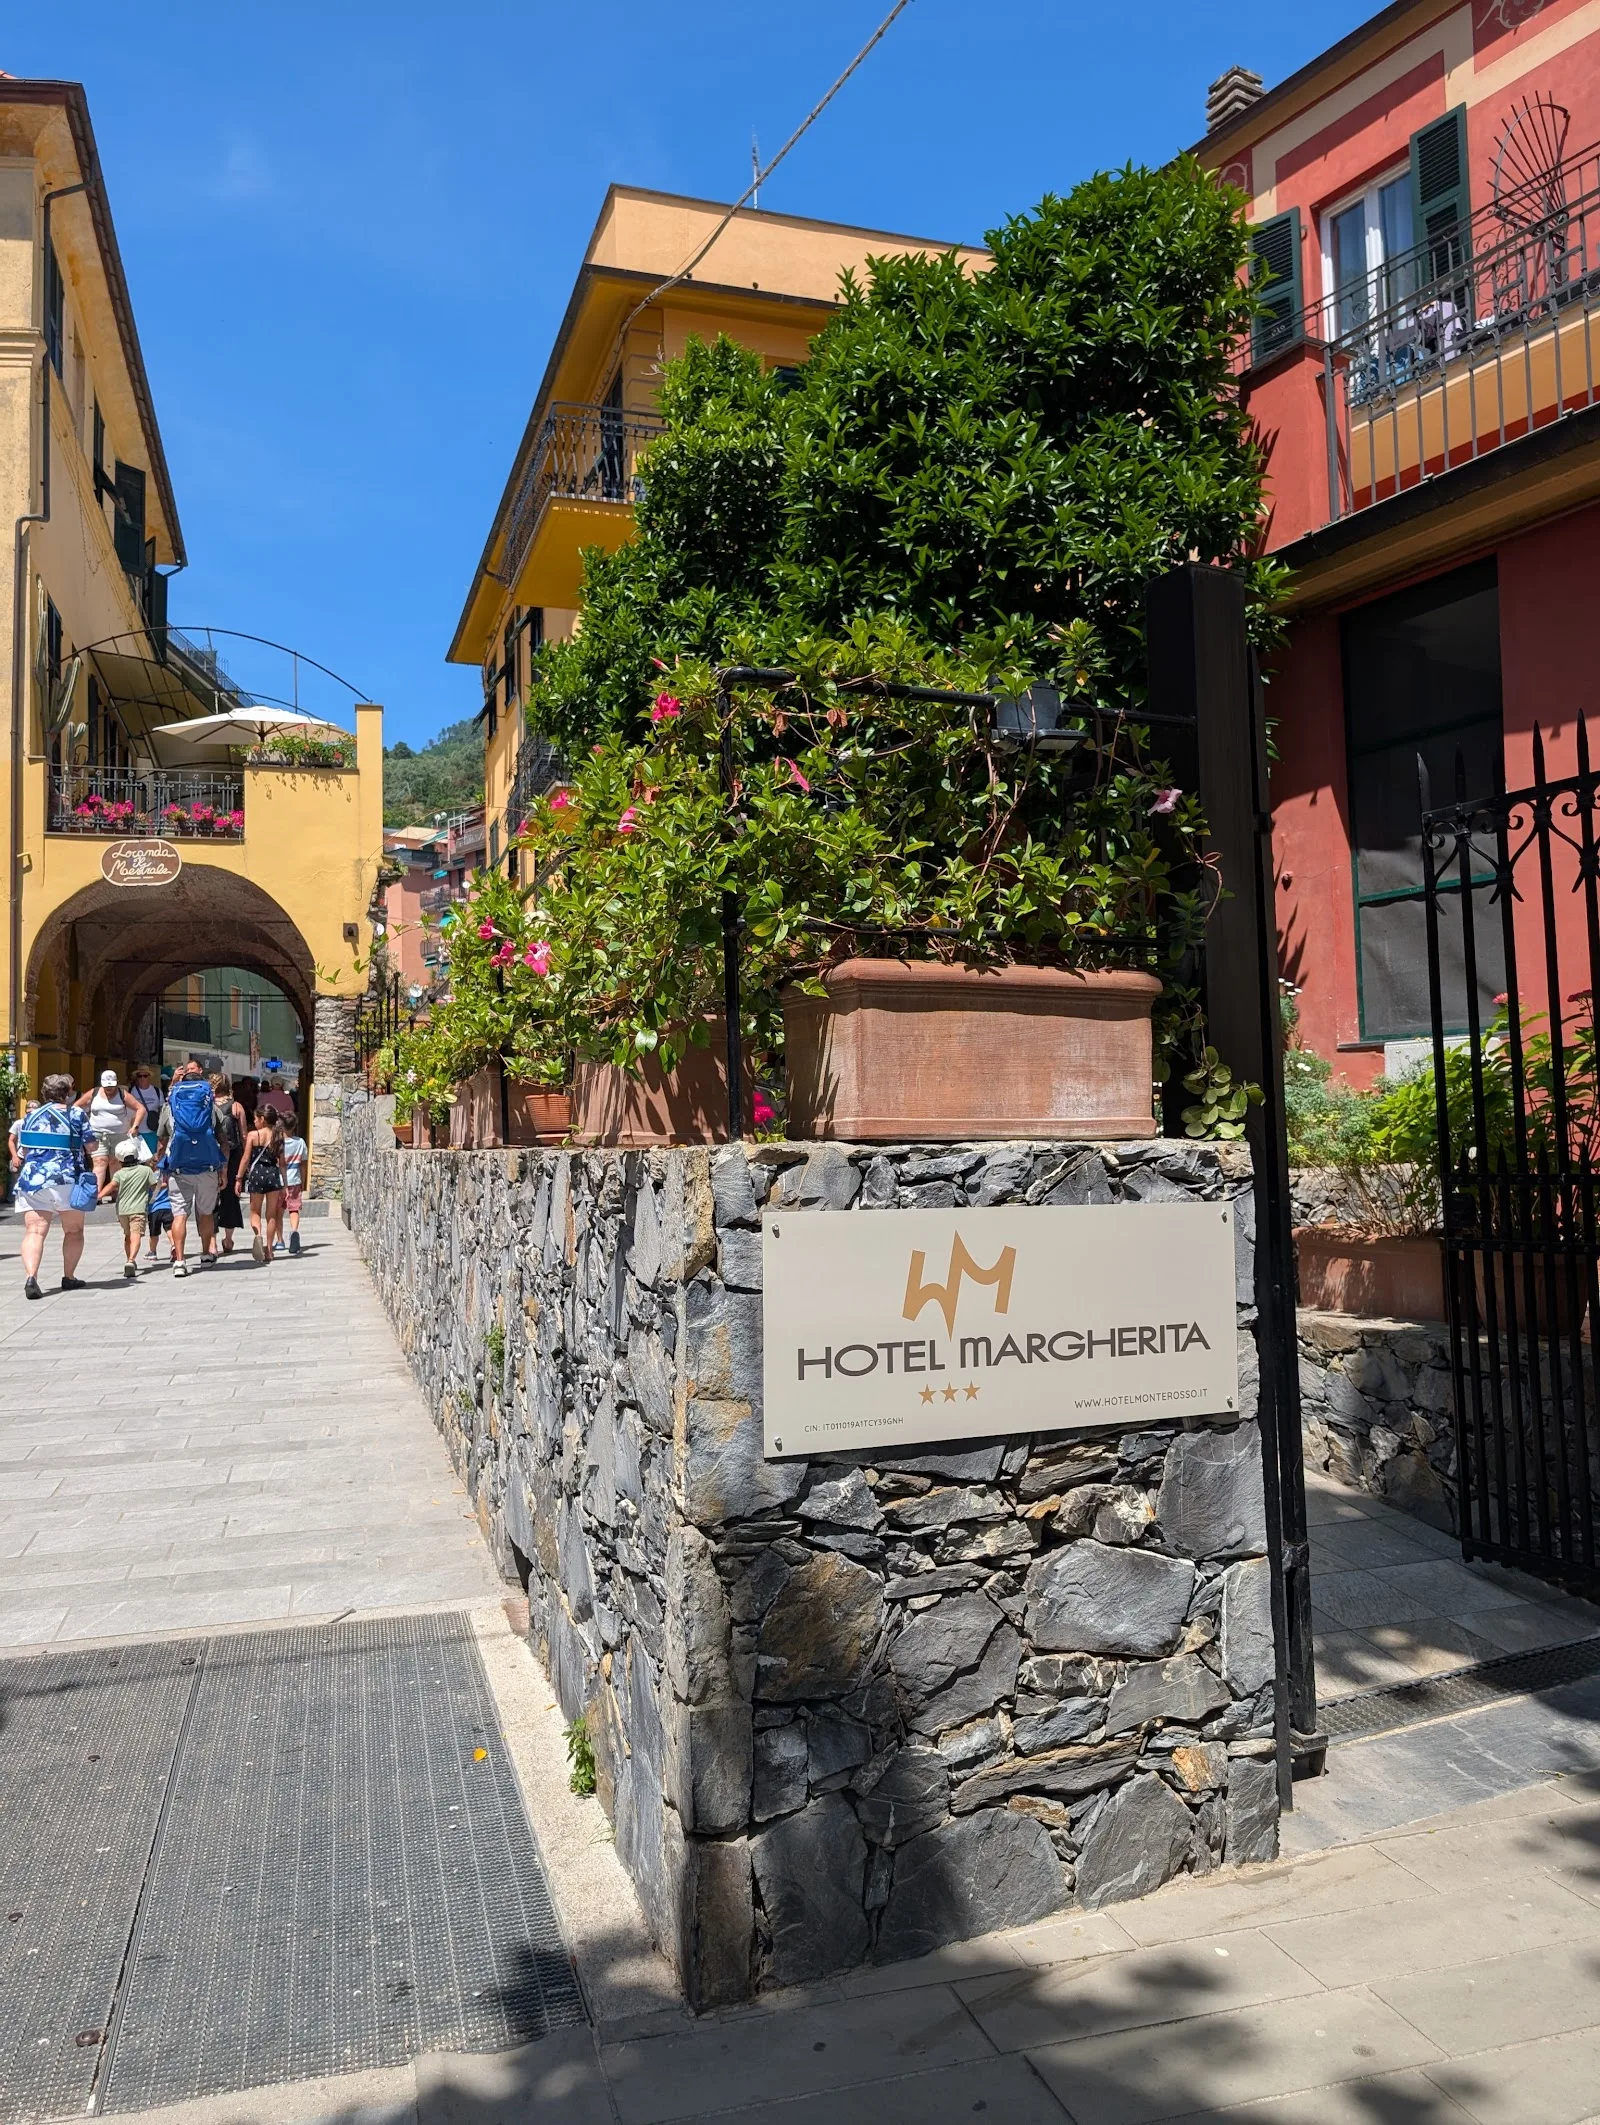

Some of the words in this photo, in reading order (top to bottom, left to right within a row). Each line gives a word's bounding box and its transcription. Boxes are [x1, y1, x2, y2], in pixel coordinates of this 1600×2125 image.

[112, 842, 176, 858] Locanda
[108, 860, 172, 878] Maestrale
[797, 1339, 946, 1380] HOTEL
[960, 1321, 1211, 1368] MARGHERITA
[1074, 1388, 1208, 1409] WWW.HOTELMONTEROSSO.IT
[804, 1425, 821, 1433] CIN:
